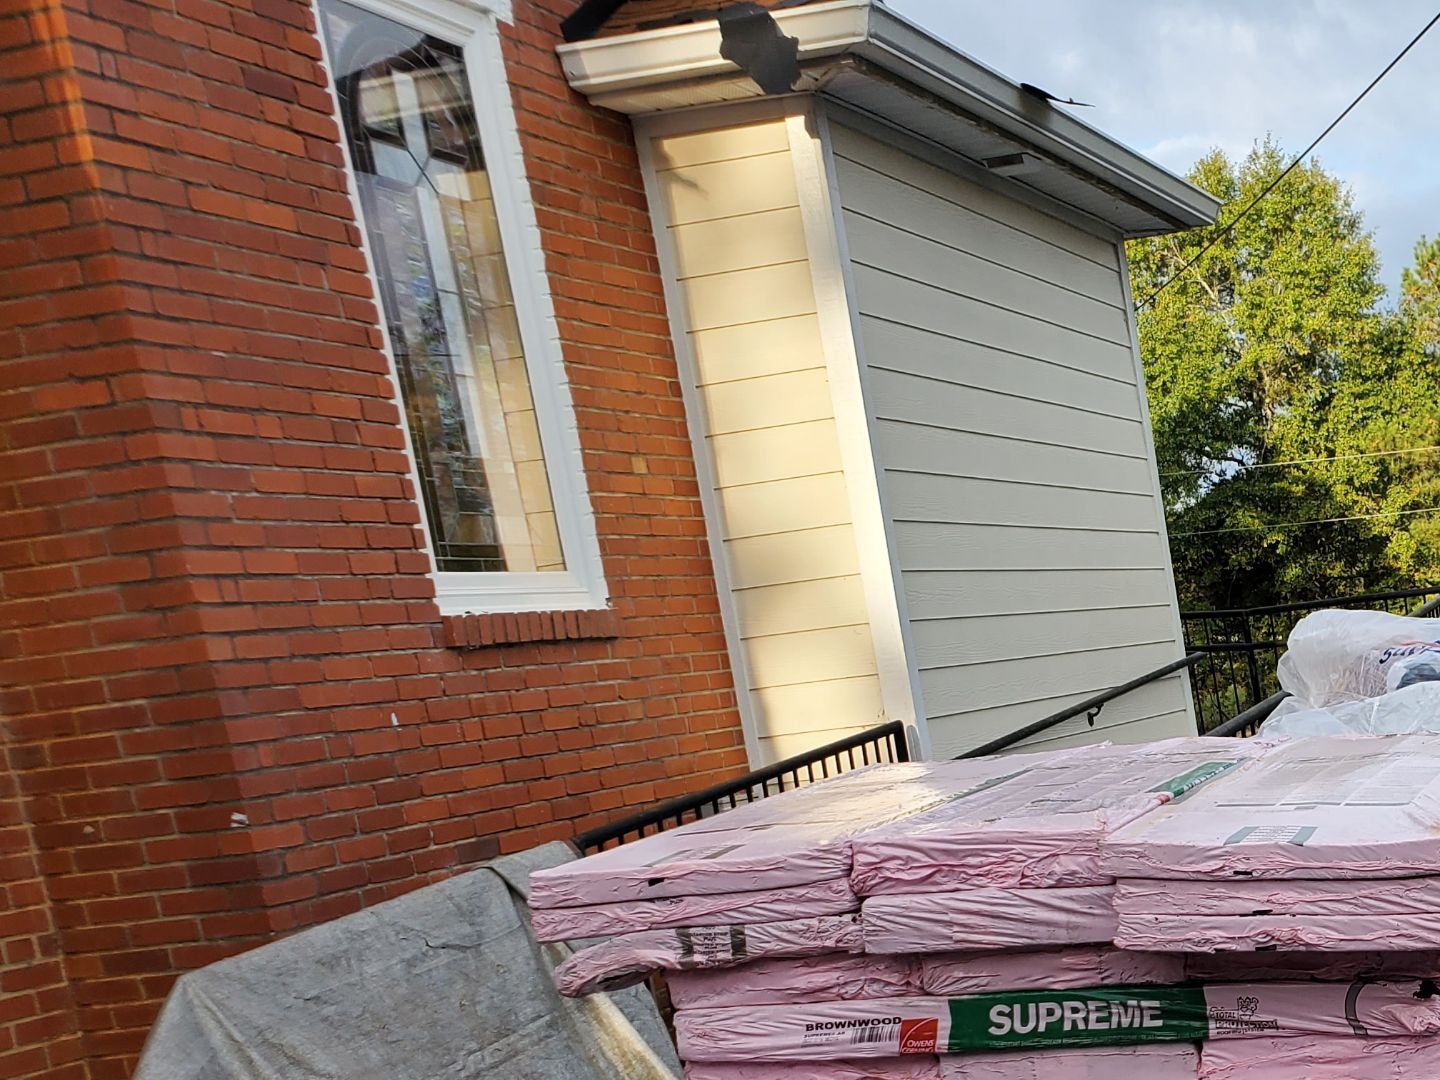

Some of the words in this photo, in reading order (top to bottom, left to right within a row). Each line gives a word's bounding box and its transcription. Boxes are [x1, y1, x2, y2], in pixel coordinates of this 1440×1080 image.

[988, 1000, 1164, 1036] SUPREME
[1215, 1012, 1236, 1020] TOTAL
[805, 1016, 902, 1032] BROWNWOOD
[907, 1039, 933, 1048] OWENS
